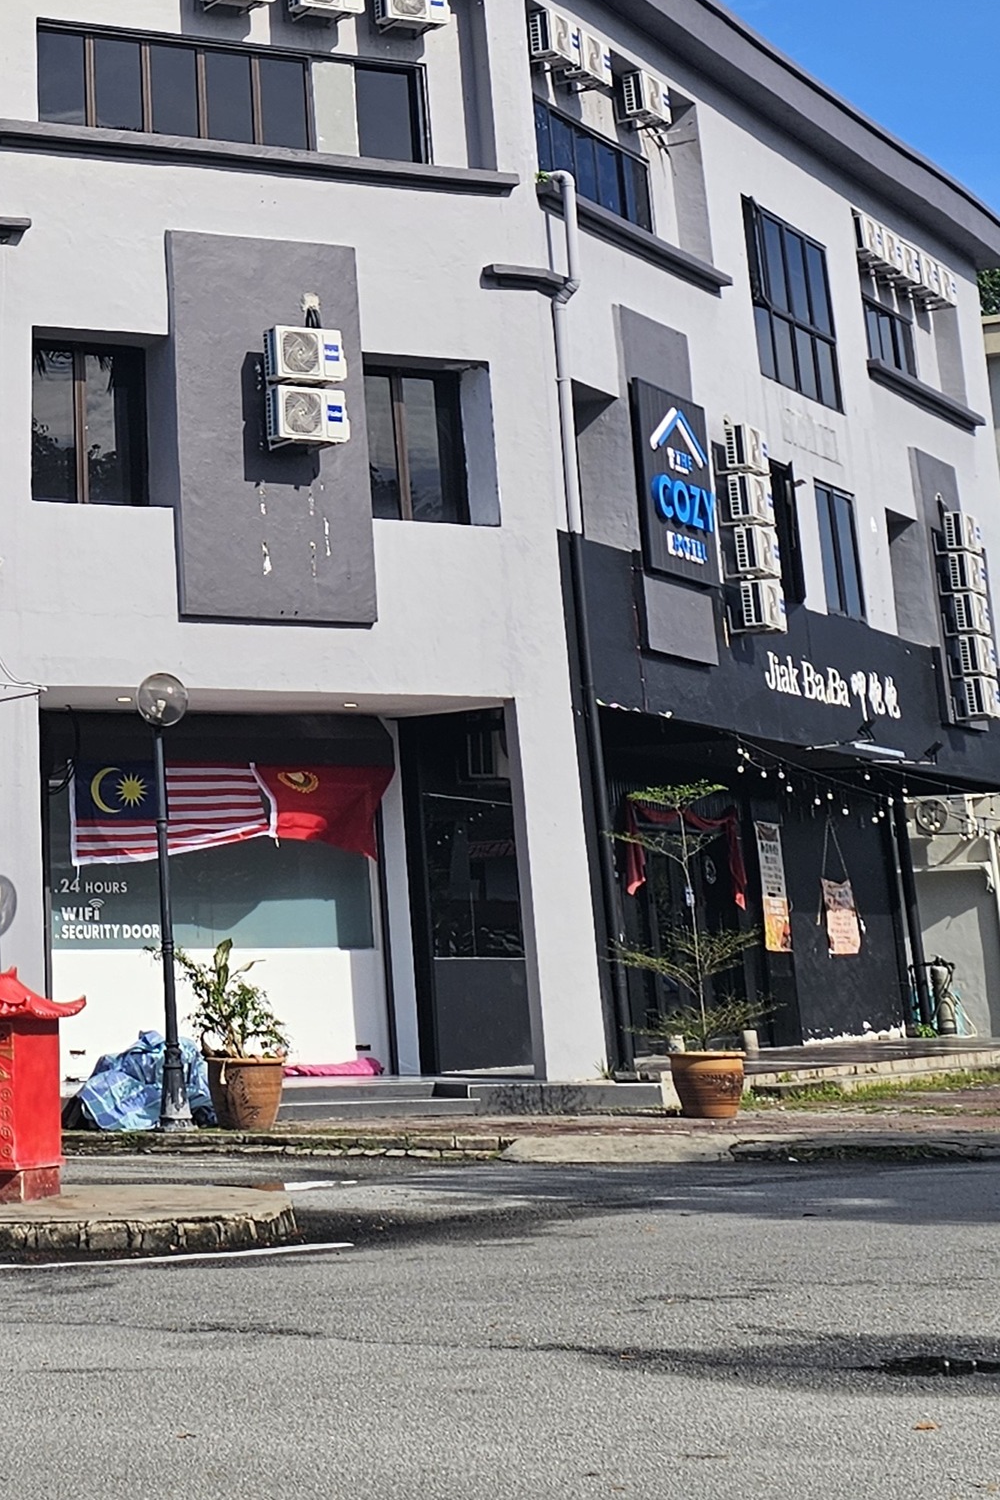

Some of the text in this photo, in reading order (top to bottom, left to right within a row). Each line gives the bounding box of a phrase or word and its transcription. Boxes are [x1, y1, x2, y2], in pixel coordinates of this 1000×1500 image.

[667, 447, 694, 475] THE
[652, 474, 715, 532] COZY
[765, 651, 802, 696] Jiak
[85, 882, 128, 893] HOURS
[122, 924, 160, 939] DOOR
